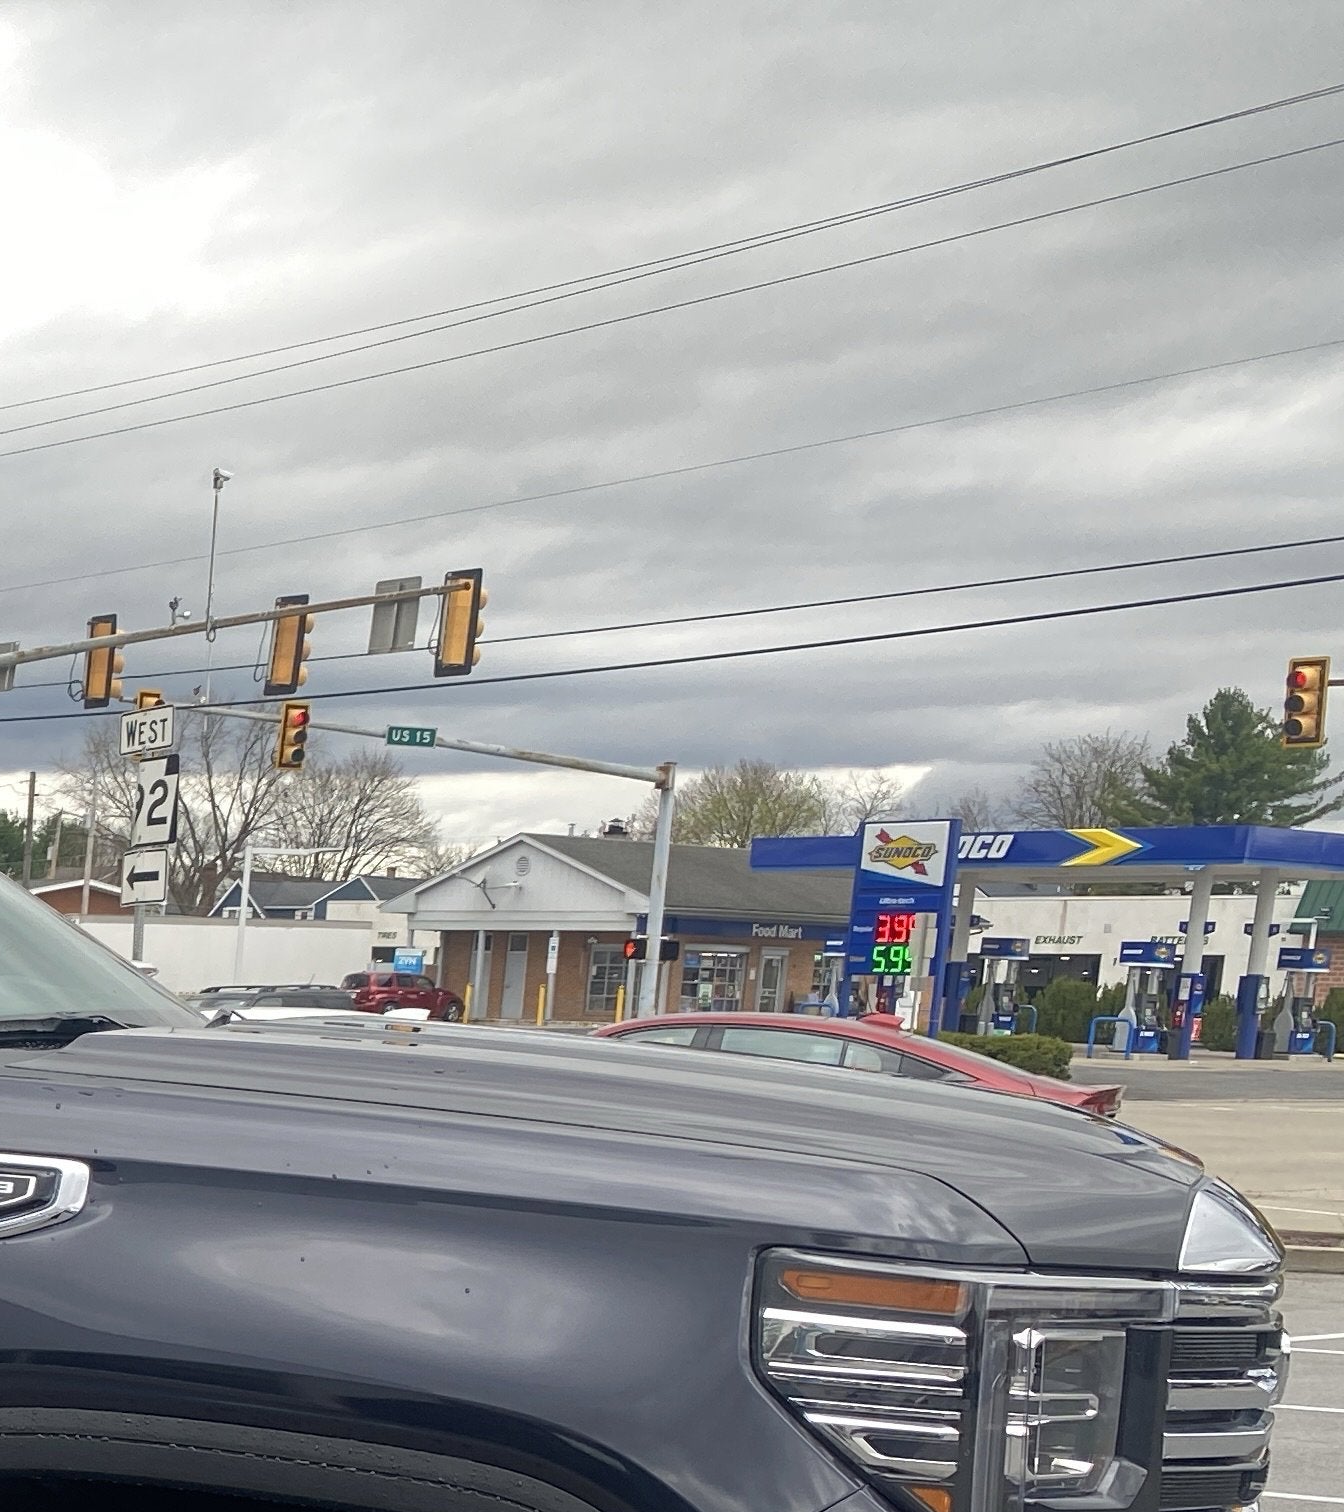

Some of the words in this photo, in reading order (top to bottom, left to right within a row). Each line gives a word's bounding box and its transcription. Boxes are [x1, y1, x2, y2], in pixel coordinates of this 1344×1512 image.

[125, 718, 168, 748] WEST
[392, 729, 410, 742] US
[415, 730, 431, 743] 15
[873, 845, 933, 859] SUNOCO
[752, 923, 776, 938] Food
[779, 924, 802, 939] Mart
[1034, 935, 1083, 945] EXHAUST
[1151, 935, 1209, 945] BATTES
